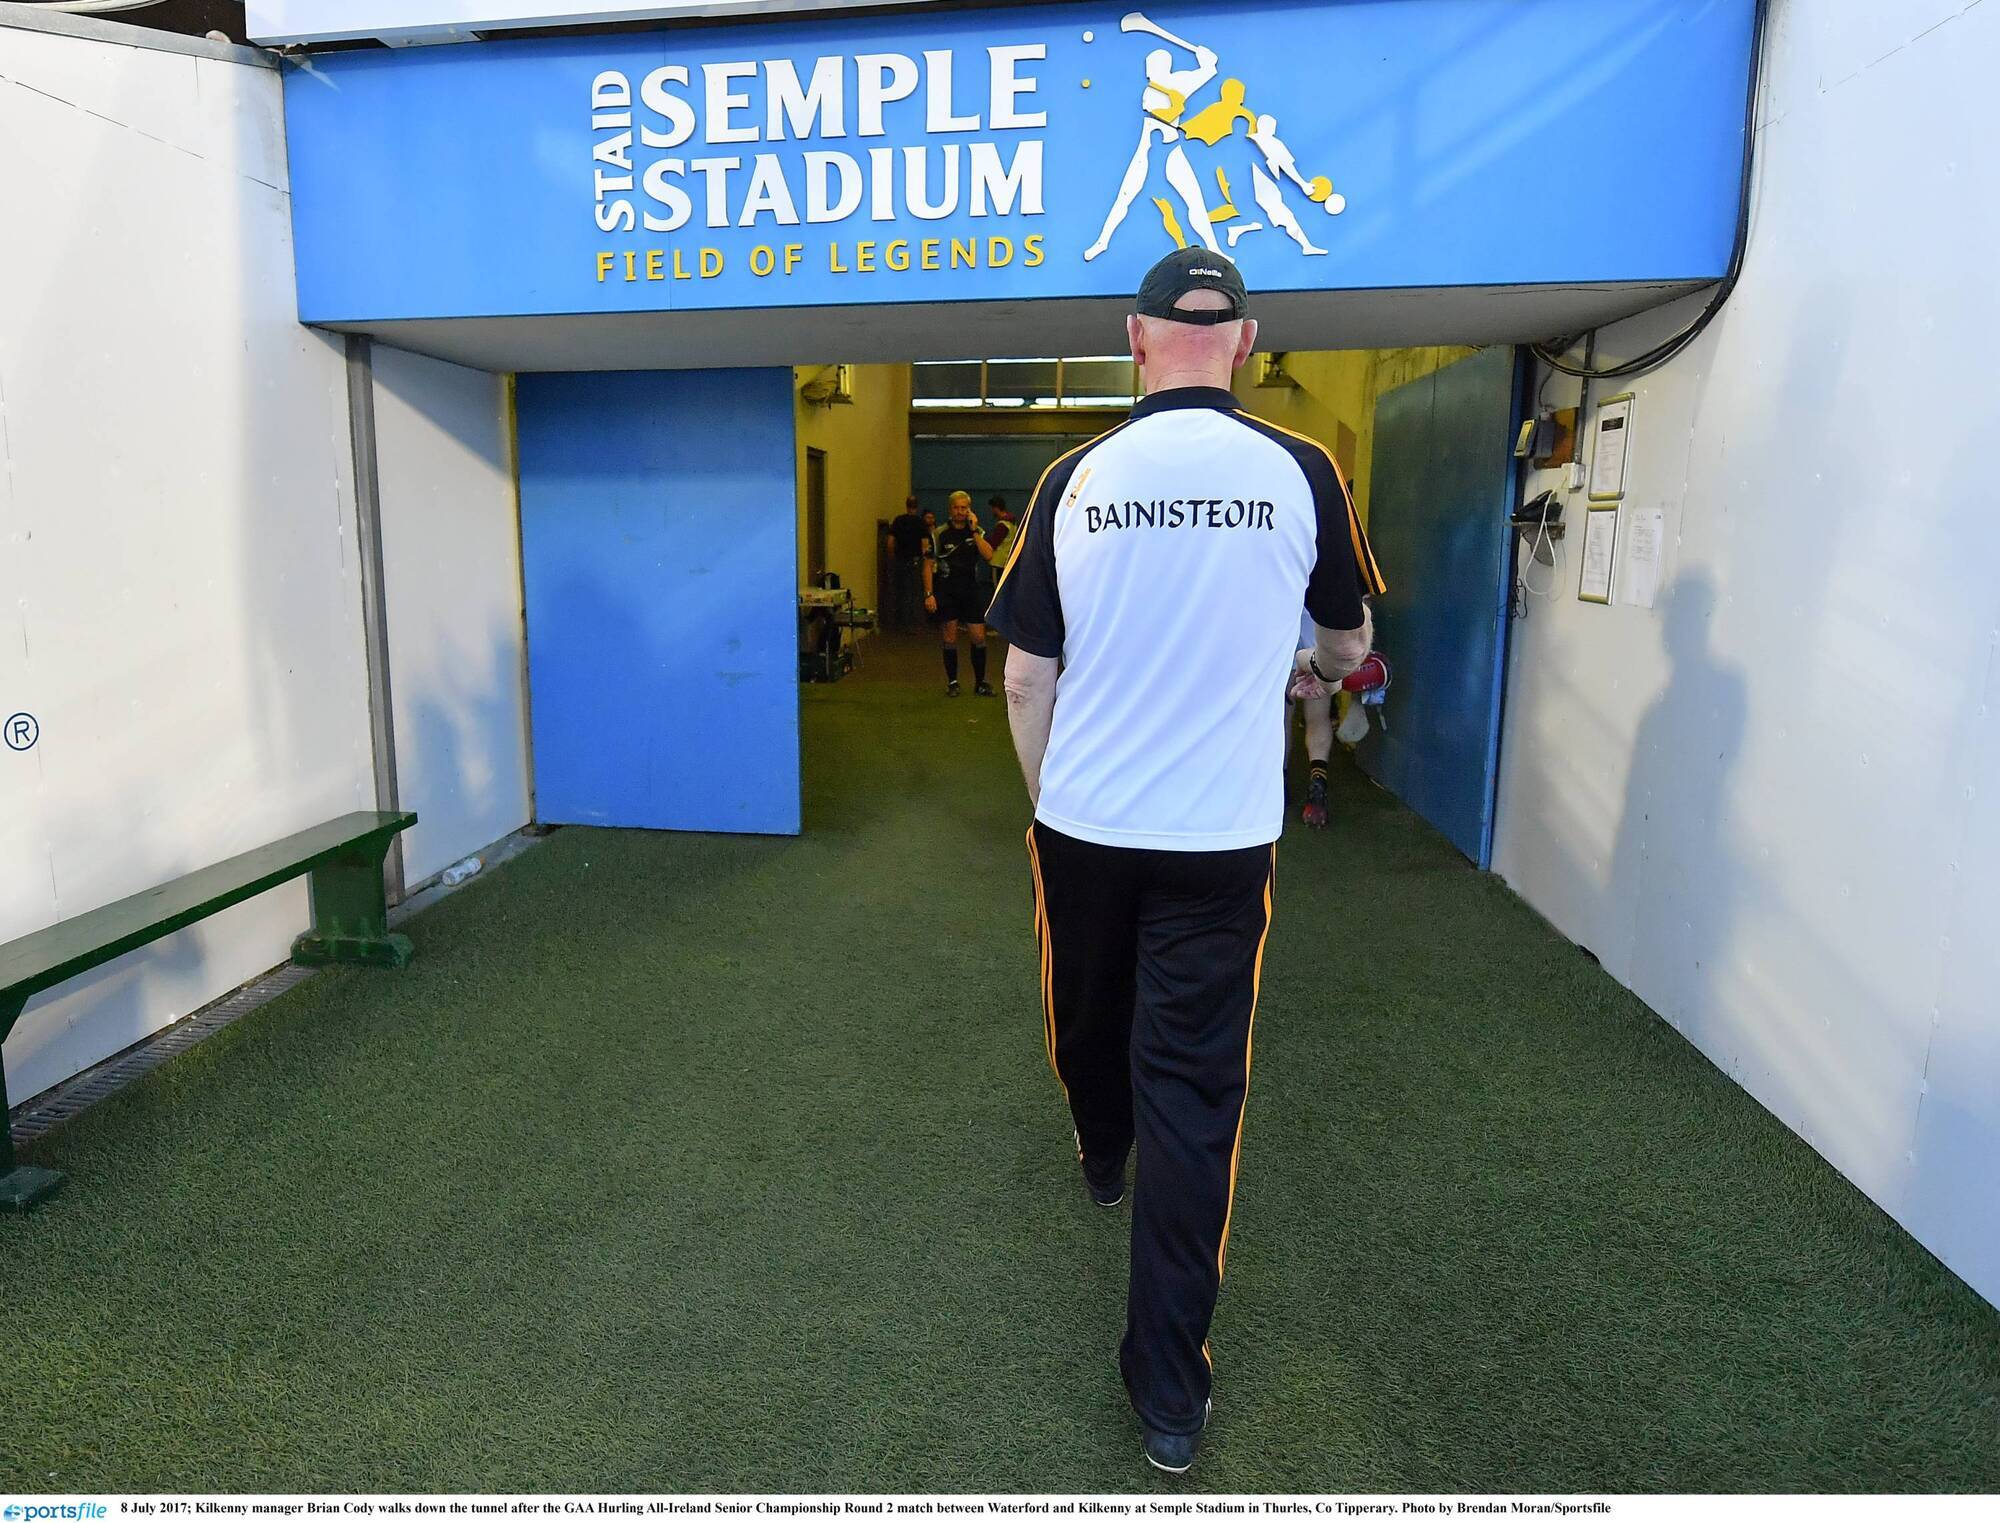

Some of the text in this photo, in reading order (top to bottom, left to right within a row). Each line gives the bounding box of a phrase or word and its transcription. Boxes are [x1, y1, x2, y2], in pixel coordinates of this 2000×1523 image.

[640, 43, 1047, 148] SEMPLE
[591, 70, 635, 232] STAID
[642, 140, 1046, 232] STADIUM
[596, 234, 1046, 282] FIELD OF LEGENDS
[1085, 499, 1275, 534] BAINISTEOIR
